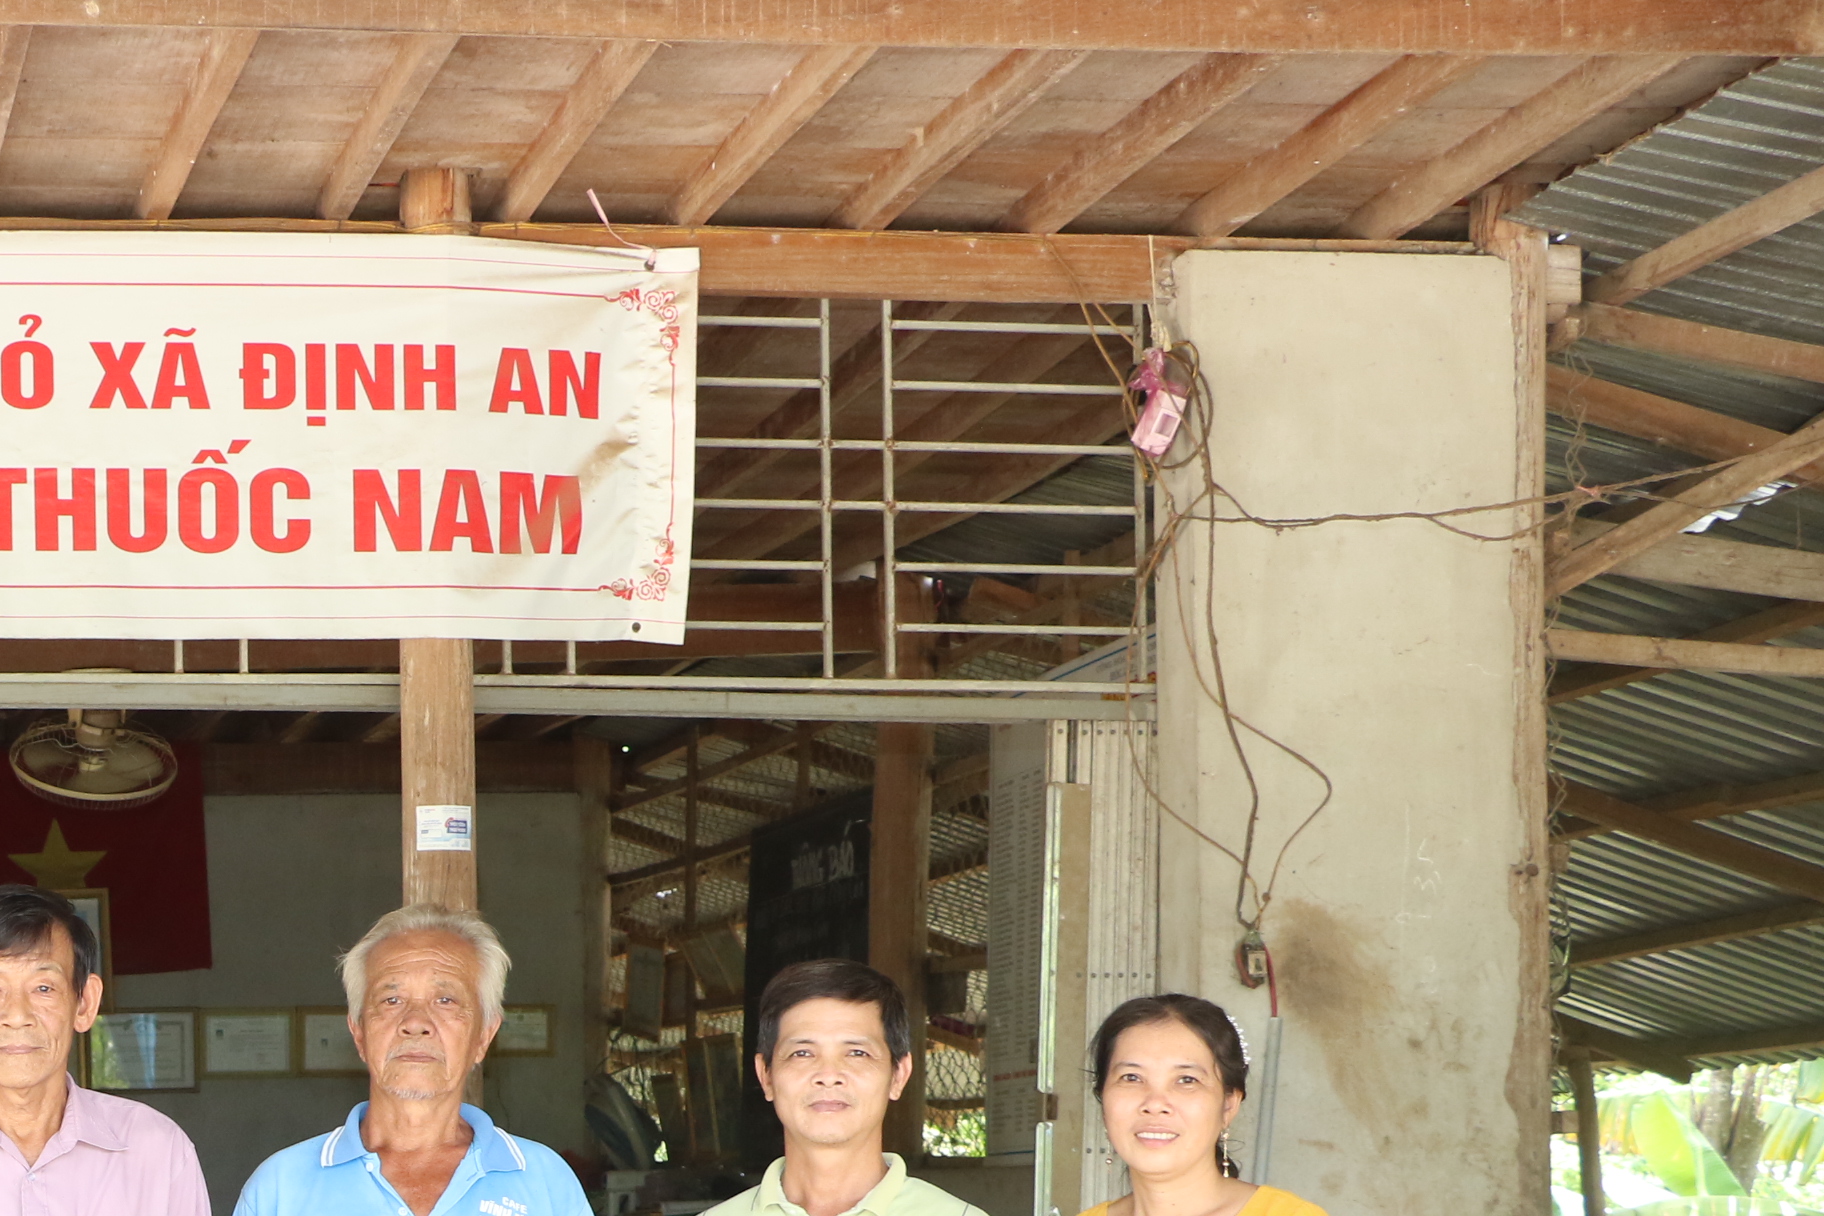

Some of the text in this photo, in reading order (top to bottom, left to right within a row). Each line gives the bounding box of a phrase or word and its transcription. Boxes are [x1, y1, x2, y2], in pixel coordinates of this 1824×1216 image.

[90, 327, 211, 410] XÃ
[239, 343, 457, 427] ĐỊNH
[488, 347, 601, 420] AN
[353, 469, 584, 556] NAM
[502, 1197, 527, 1214] CAFE
